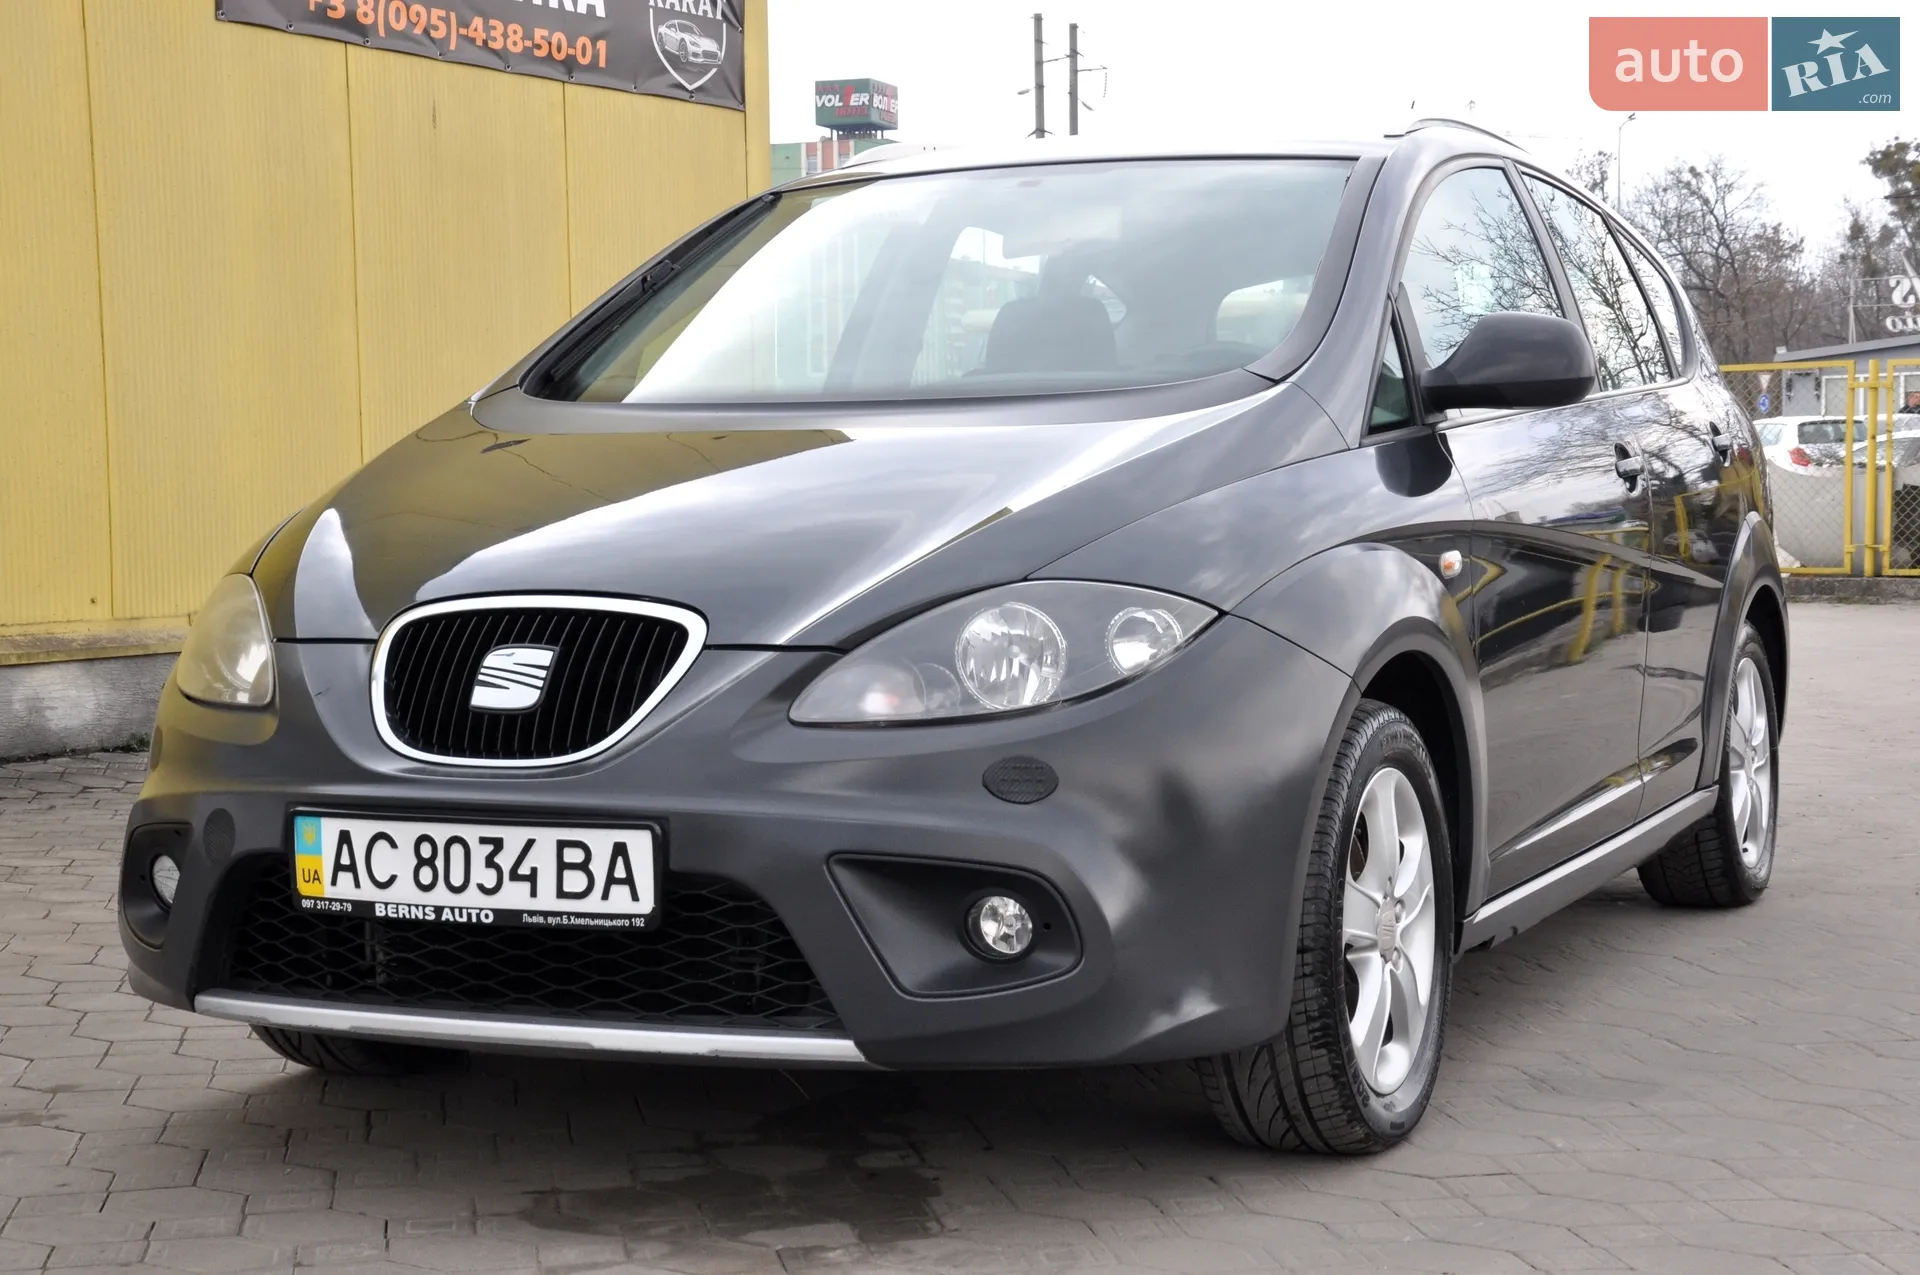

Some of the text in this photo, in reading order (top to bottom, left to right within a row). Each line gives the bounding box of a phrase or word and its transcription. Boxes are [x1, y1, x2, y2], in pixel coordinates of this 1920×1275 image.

[356, 0, 607, 68] 8(095)-438-50-01
[330, 829, 640, 902] AC 8034 BA
[302, 868, 322, 885] UA
[301, 899, 352, 912] 097 317-29-79
[375, 902, 494, 923] BERNS AUTO
[522, 913, 546, 924] Львів,
[631, 917, 645, 927] 192
